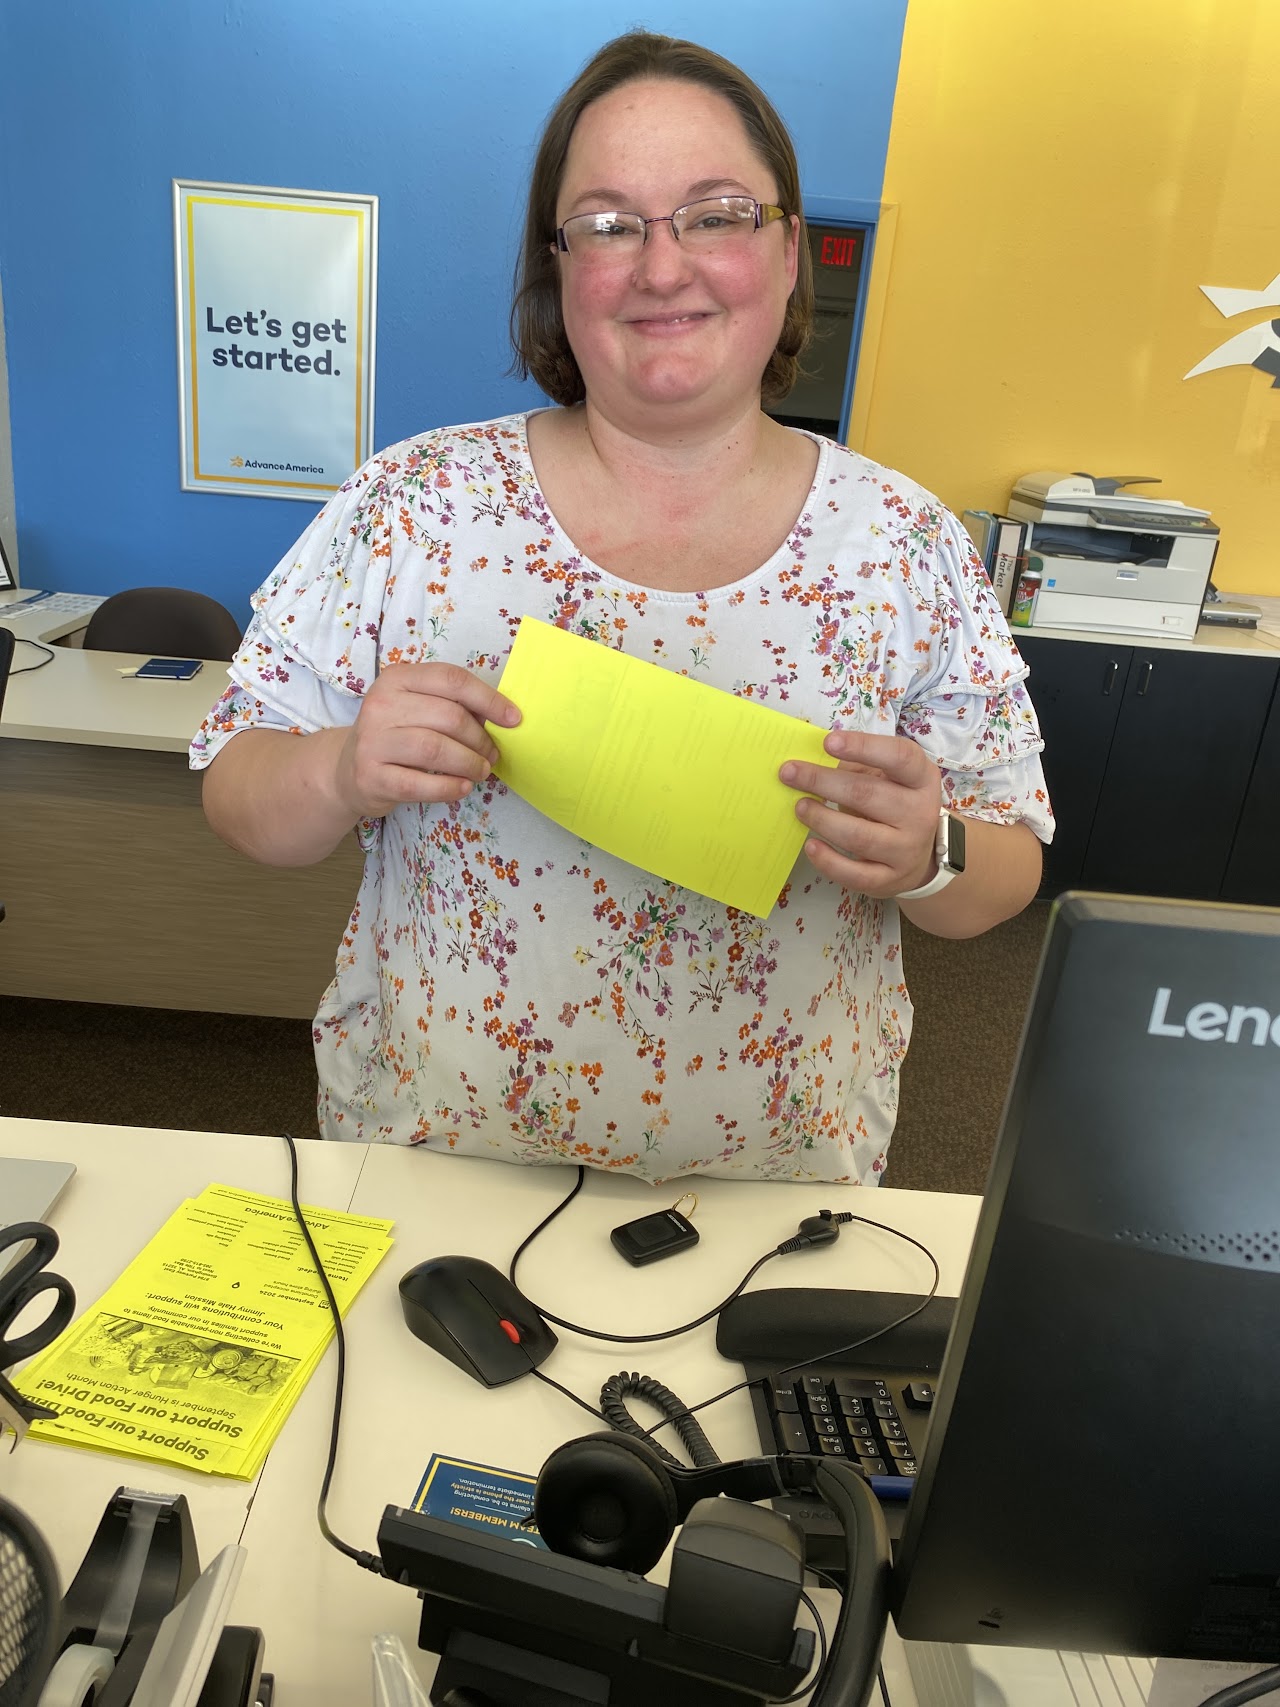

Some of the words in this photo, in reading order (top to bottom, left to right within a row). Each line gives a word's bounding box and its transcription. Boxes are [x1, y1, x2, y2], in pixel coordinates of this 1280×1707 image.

[821, 236, 856, 267] EXIT
[292, 318, 347, 348] get
[212, 343, 341, 376] started.
[245, 459, 324, 474] AdvanceAmerica
[996, 552, 1009, 588] Market
[1147, 987, 1280, 1048] Len
[327, 1273, 349, 1281] Items
[145, 1293, 183, 1305] support:
[184, 1294, 217, 1306] Mission
[277, 1294, 315, 1306] September
[290, 1289, 319, 1299] Donations
[218, 1303, 237, 1311] Hale
[237, 1306, 266, 1317] Jimmy
[132, 1310, 152, 1319] items
[152, 1315, 170, 1323] food
[202, 1306, 262, 1324] contributions
[170, 1320, 224, 1335] non-perishable
[211, 1321, 239, 1332] families
[263, 1321, 283, 1330] Your
[224, 1331, 260, 1344] collecting
[239, 1328, 268, 1338] support
[66, 1373, 99, 1387] Month
[35, 1379, 91, 1402] Drive!
[99, 1381, 133, 1395] Action
[89, 1393, 136, 1413] Food
[132, 1390, 169, 1404] Hunger
[170, 1399, 180, 1407] is
[136, 1405, 167, 1418] our
[180, 1402, 236, 1420] September
[820, 1404, 827, 1412] 3
[853, 1406, 860, 1414] 2
[888, 1408, 893, 1416] 1
[58, 1406, 106, 1427] Food
[105, 1420, 136, 1435] our
[169, 1412, 243, 1438] Support
[827, 1425, 834, 1433] 6
[137, 1430, 209, 1461] Support
[834, 1445, 842, 1453] 9
[451, 1483, 474, 1492] strictly
[459, 1479, 496, 1491] termination.
[454, 1490, 490, 1502] conducting
[483, 1489, 504, 1498] phone
[497, 1487, 531, 1498] immediate
[510, 1504, 530, 1512] claims
[450, 1507, 507, 1526] MEMBERS!
